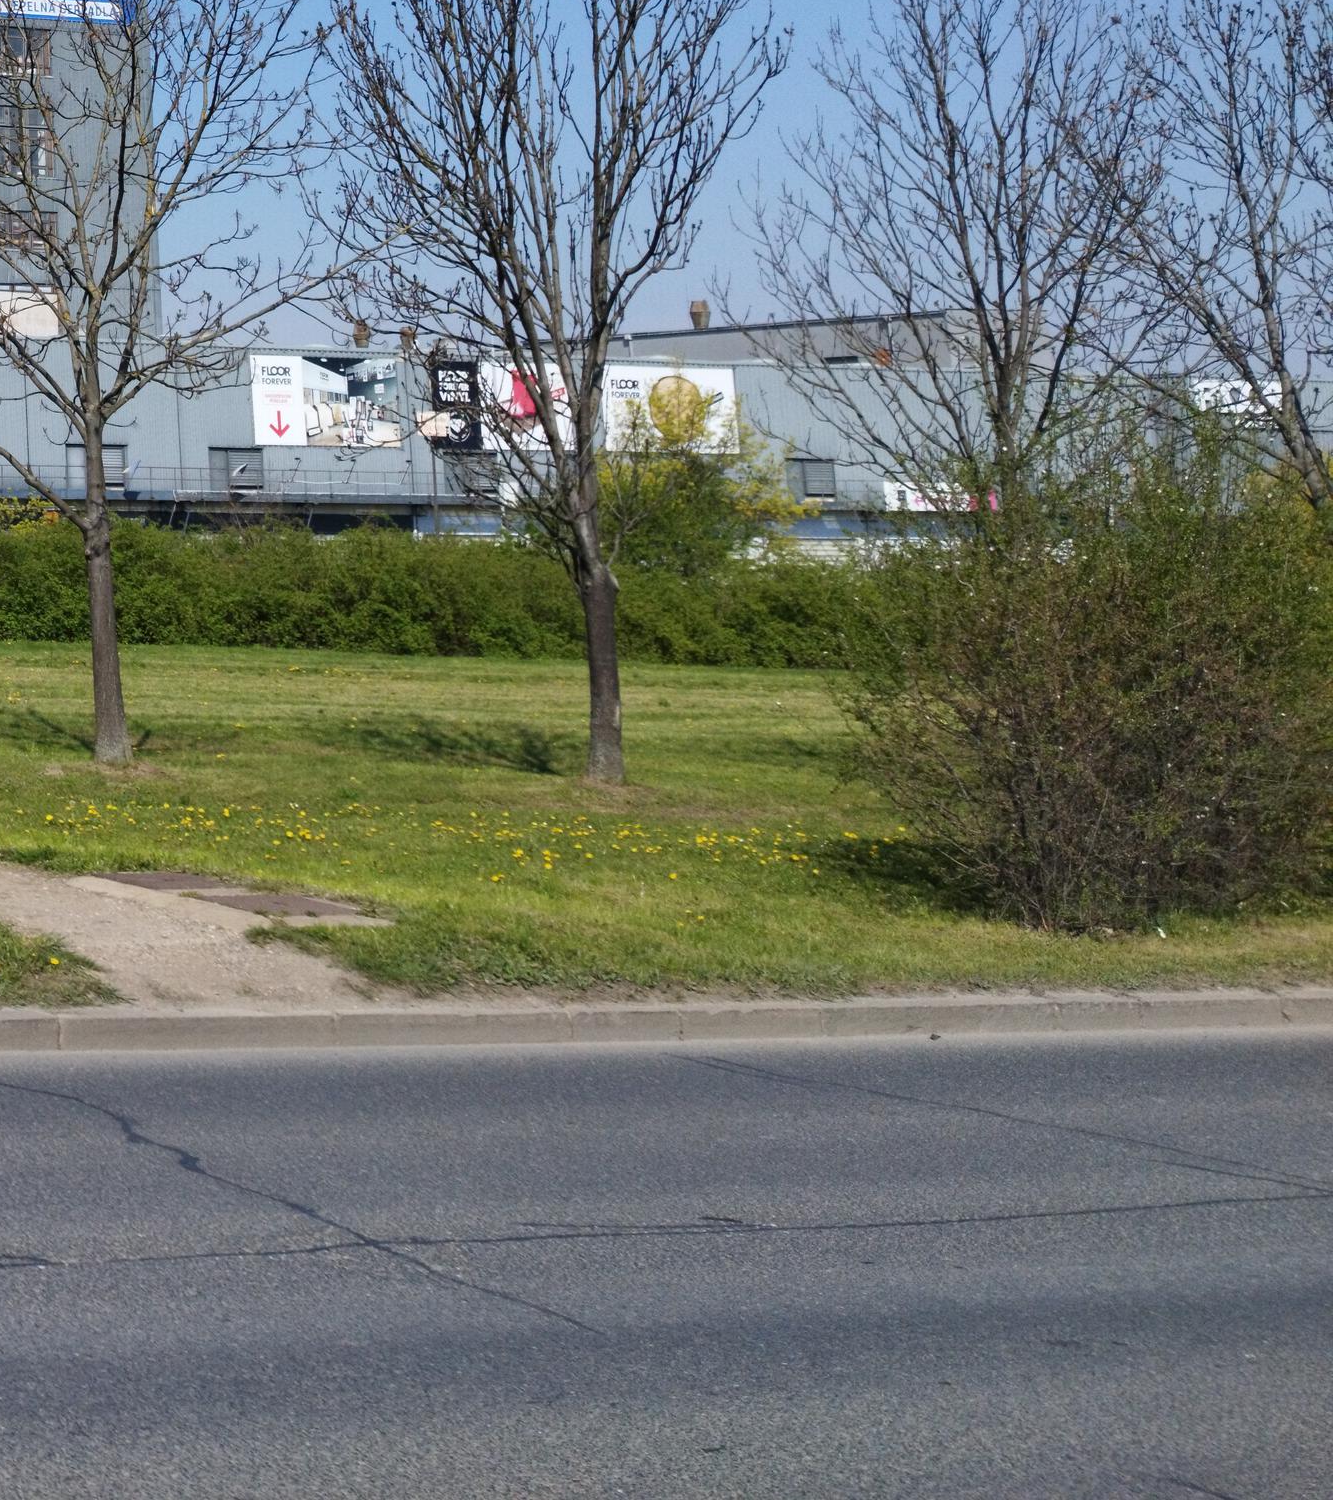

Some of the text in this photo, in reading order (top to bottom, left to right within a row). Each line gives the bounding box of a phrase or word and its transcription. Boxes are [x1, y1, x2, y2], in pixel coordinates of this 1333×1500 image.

[5, 0, 55, 14] EPELNÁ
[261, 366, 291, 377] FLOOR
[261, 377, 292, 385] FOREVER
[611, 379, 639, 389] FLOOR
[611, 391, 640, 399] FOREVER
